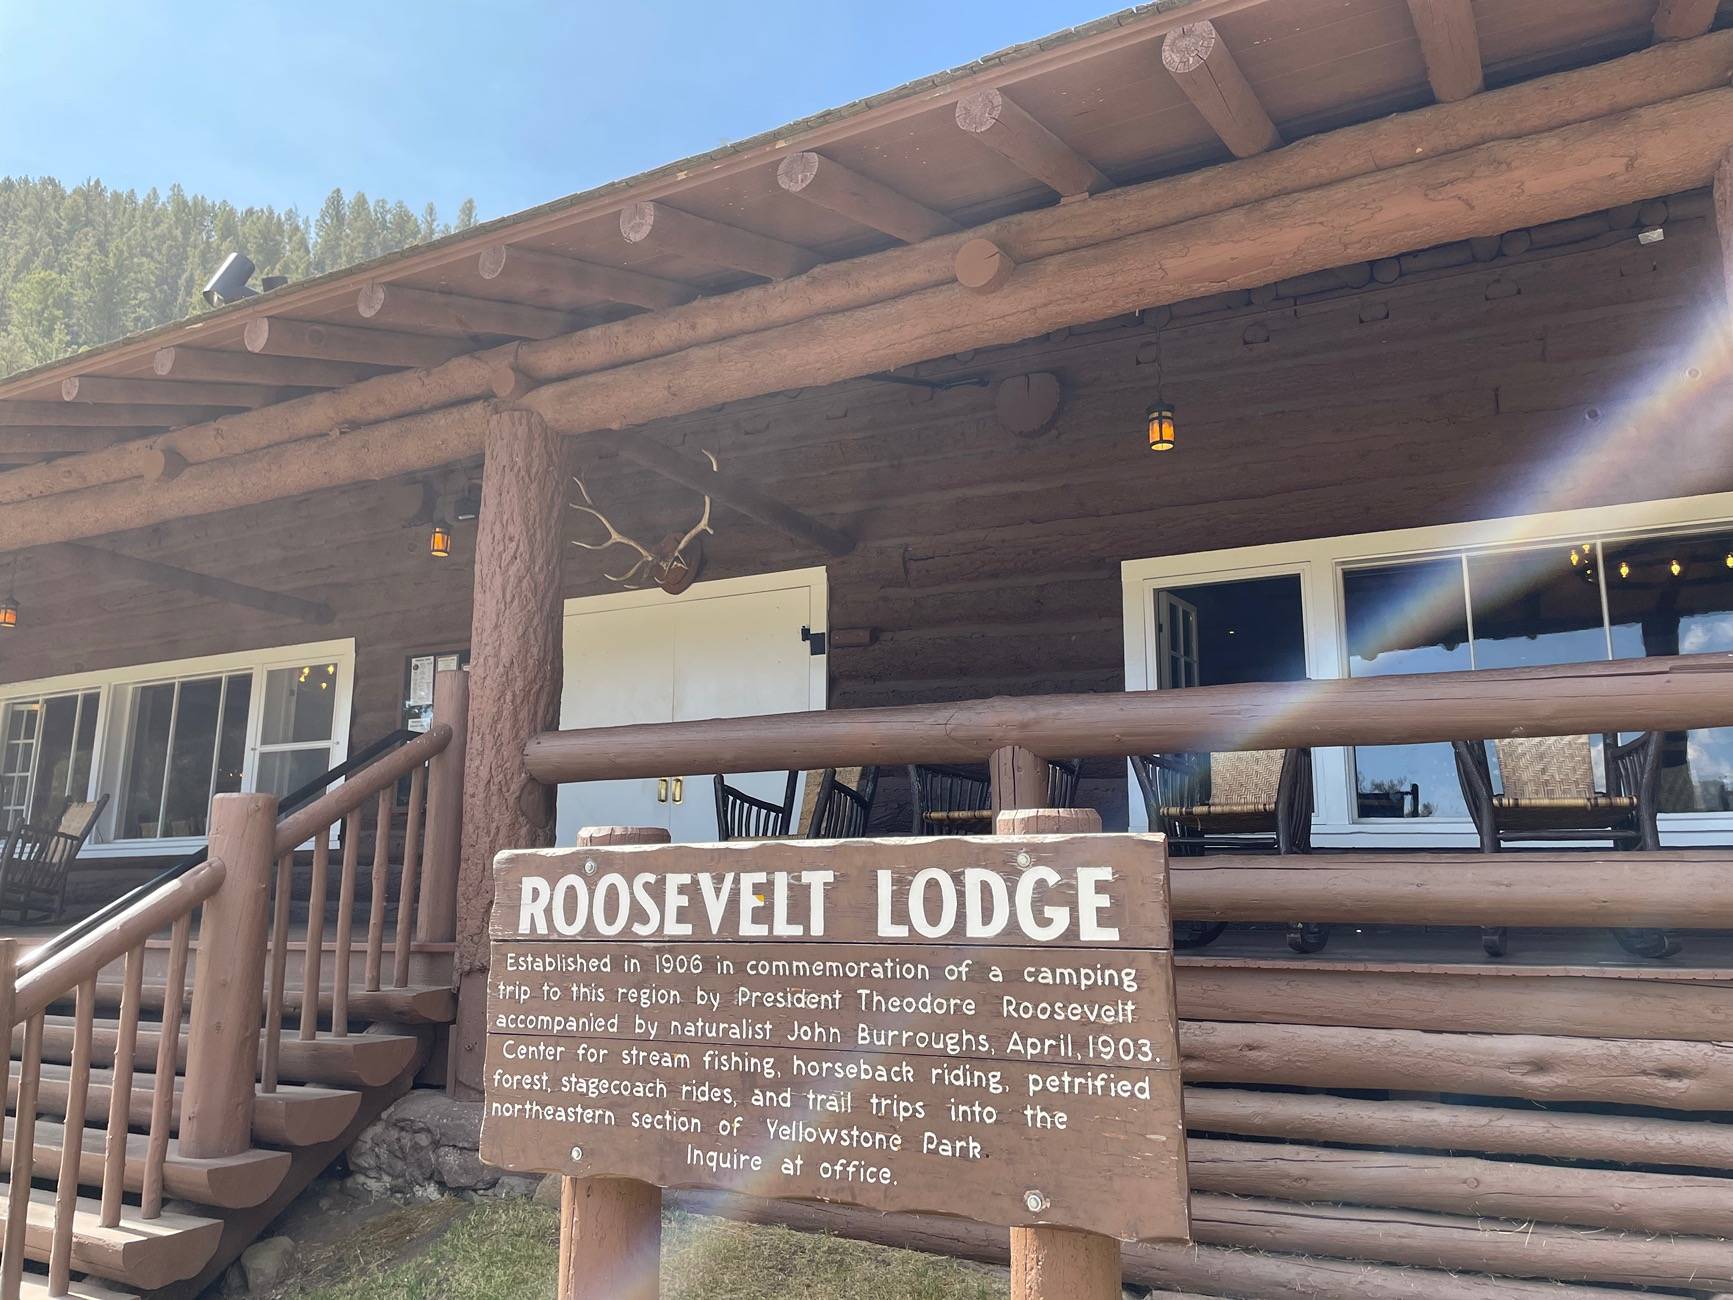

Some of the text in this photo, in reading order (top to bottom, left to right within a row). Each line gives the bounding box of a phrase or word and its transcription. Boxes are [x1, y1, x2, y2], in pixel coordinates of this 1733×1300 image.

[516, 865, 1120, 943] ROOSEVELT LODGE
[507, 953, 1138, 993] Established in 1906 in commemoration of a camping
[497, 981, 1136, 1024] trip to this region by President Theodore Roosevelt
[495, 1012, 618, 1034] accompanied
[634, 1014, 658, 1040] by
[670, 1017, 773, 1040] naturalist
[787, 1020, 841, 1043] John
[857, 1023, 995, 1055] Burroughs,
[502, 1039, 1151, 1100] Center for stream fishing, horseback riding, petrified
[492, 1068, 1068, 1130] forest, stagecoach rides, and trail trips into the
[491, 1100, 615, 1126] northeastern
[631, 1110, 701, 1133] section
[718, 1116, 744, 1137] of
[766, 1118, 902, 1152] Yellowstone
[687, 1143, 898, 1186] Inquire at office.
